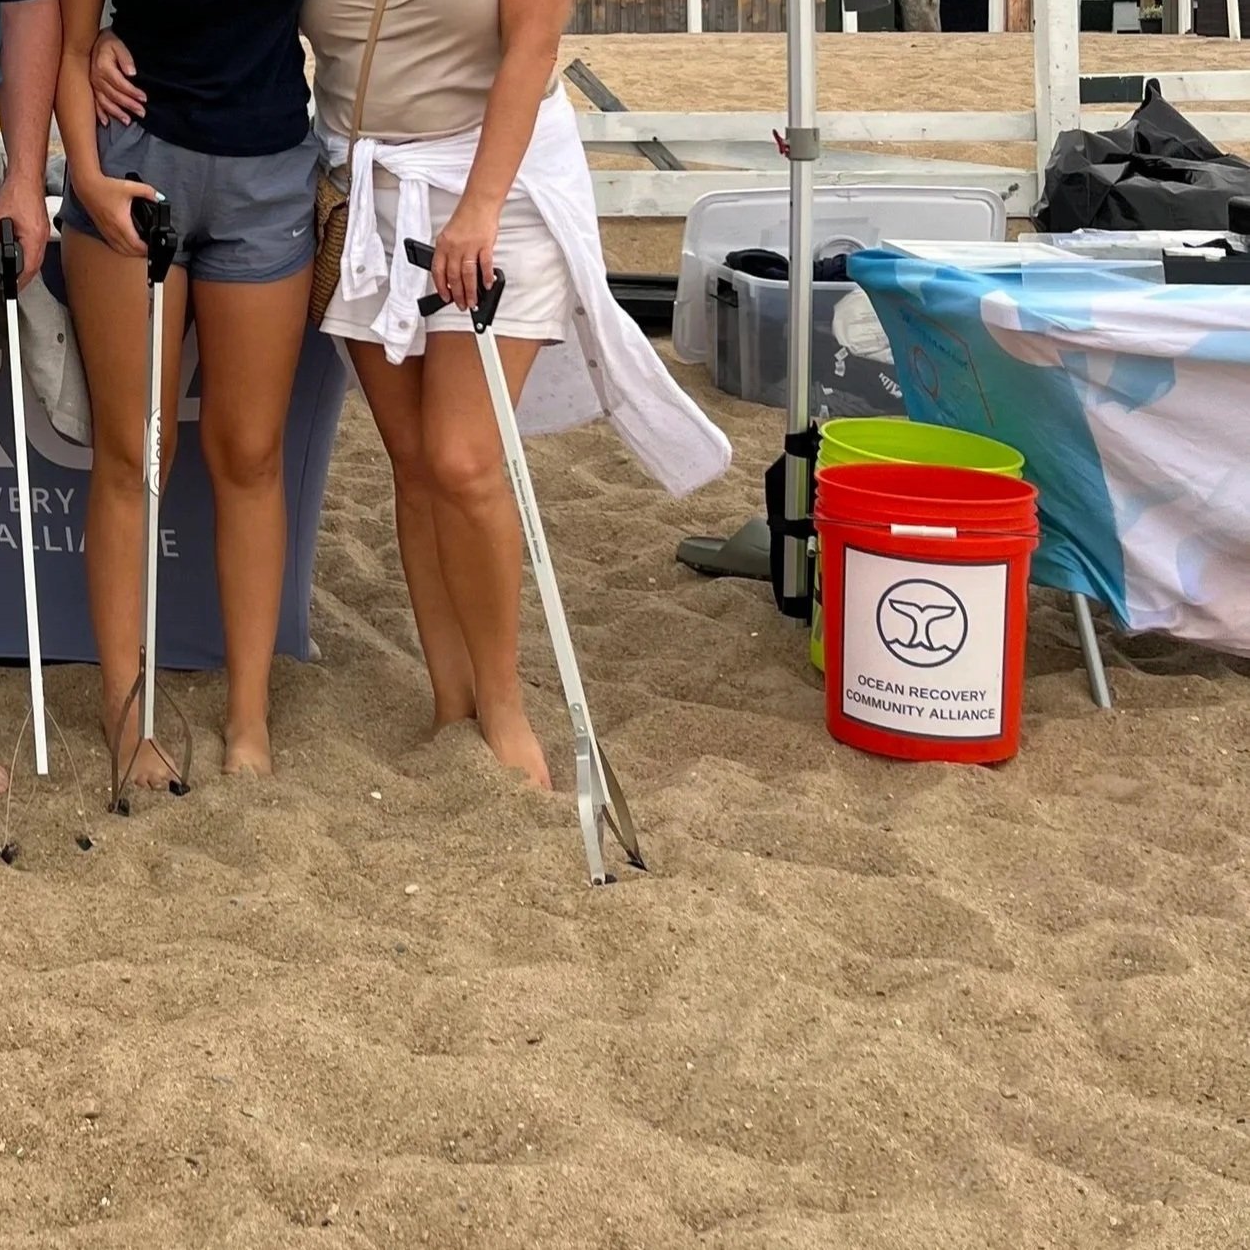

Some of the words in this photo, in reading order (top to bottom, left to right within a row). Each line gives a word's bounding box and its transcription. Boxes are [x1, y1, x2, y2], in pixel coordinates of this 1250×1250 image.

[857, 674, 905, 696] OCEAN
[908, 685, 987, 702] RECOVERY
[845, 688, 925, 718] COMMUNITY
[928, 708, 996, 721] ALLIANCE
